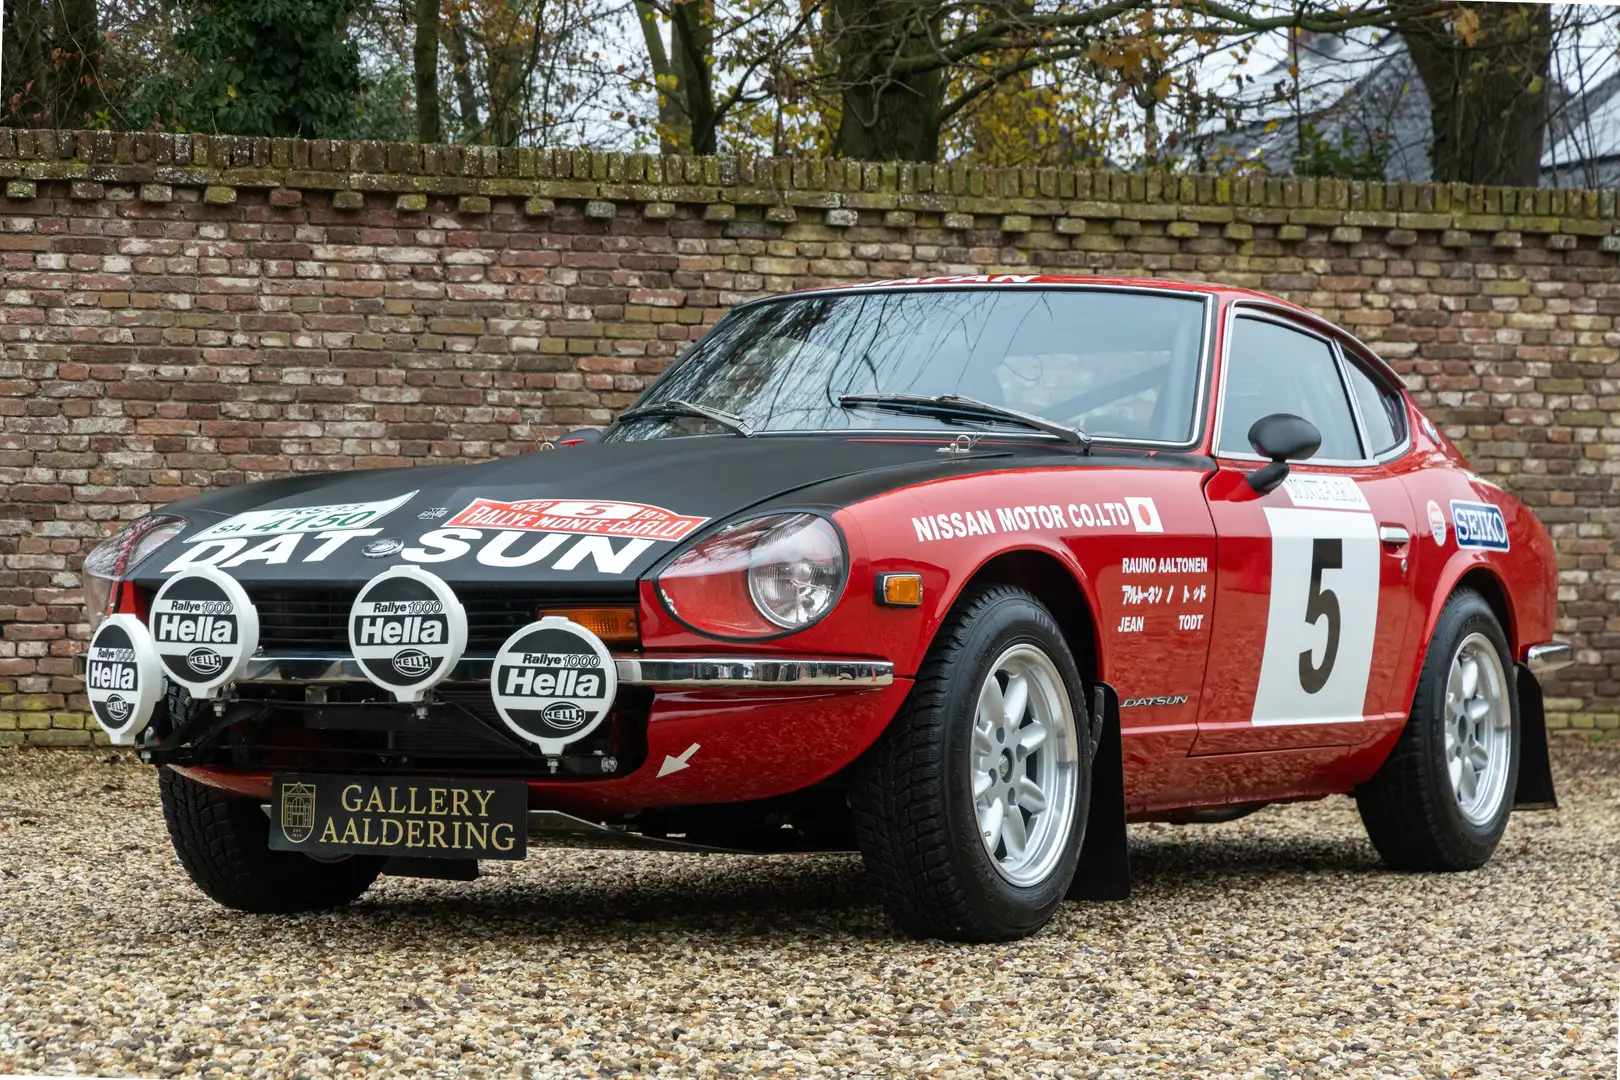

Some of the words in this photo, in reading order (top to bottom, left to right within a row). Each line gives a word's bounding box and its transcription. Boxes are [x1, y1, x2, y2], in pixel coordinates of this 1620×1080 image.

[510, 502, 553, 513] 1972
[574, 504, 608, 518] 5
[212, 523, 248, 534] SA
[253, 510, 377, 532] 4150
[460, 505, 534, 528] RALLYE
[537, 516, 686, 538] MONTE-CARLO
[911, 509, 997, 542] NISSAN
[996, 504, 1068, 532] MOTOR
[1068, 502, 1130, 528] CO.LTD
[1454, 508, 1506, 544] SEIKO
[160, 527, 385, 574] DAT
[400, 528, 656, 574] SUN
[1122, 558, 1156, 574] RAUNO
[1158, 557, 1208, 573] AALTONEN
[170, 601, 201, 613] Rallye
[201, 601, 234, 614] 1000
[373, 602, 407, 614] Rallye
[408, 601, 443, 614] 1000
[1298, 538, 1343, 694] 5
[158, 615, 232, 642] Hella
[360, 616, 443, 645] Hella
[1117, 616, 1144, 633] JEAN
[1178, 615, 1204, 630] TODT
[97, 648, 115, 660] Rallye
[115, 649, 136, 662] 1000
[189, 654, 222, 668] HELLA
[395, 655, 431, 668] HELLA
[522, 653, 562, 665] Rallye
[562, 654, 601, 668] 1000
[91, 663, 135, 690] Hella
[504, 668, 600, 697] Hella
[106, 699, 128, 713] HELLA
[1120, 695, 1188, 708] DATSUN
[545, 709, 586, 722] HELLA
[341, 784, 496, 817] GALLERY
[319, 817, 516, 852] AALDERING
